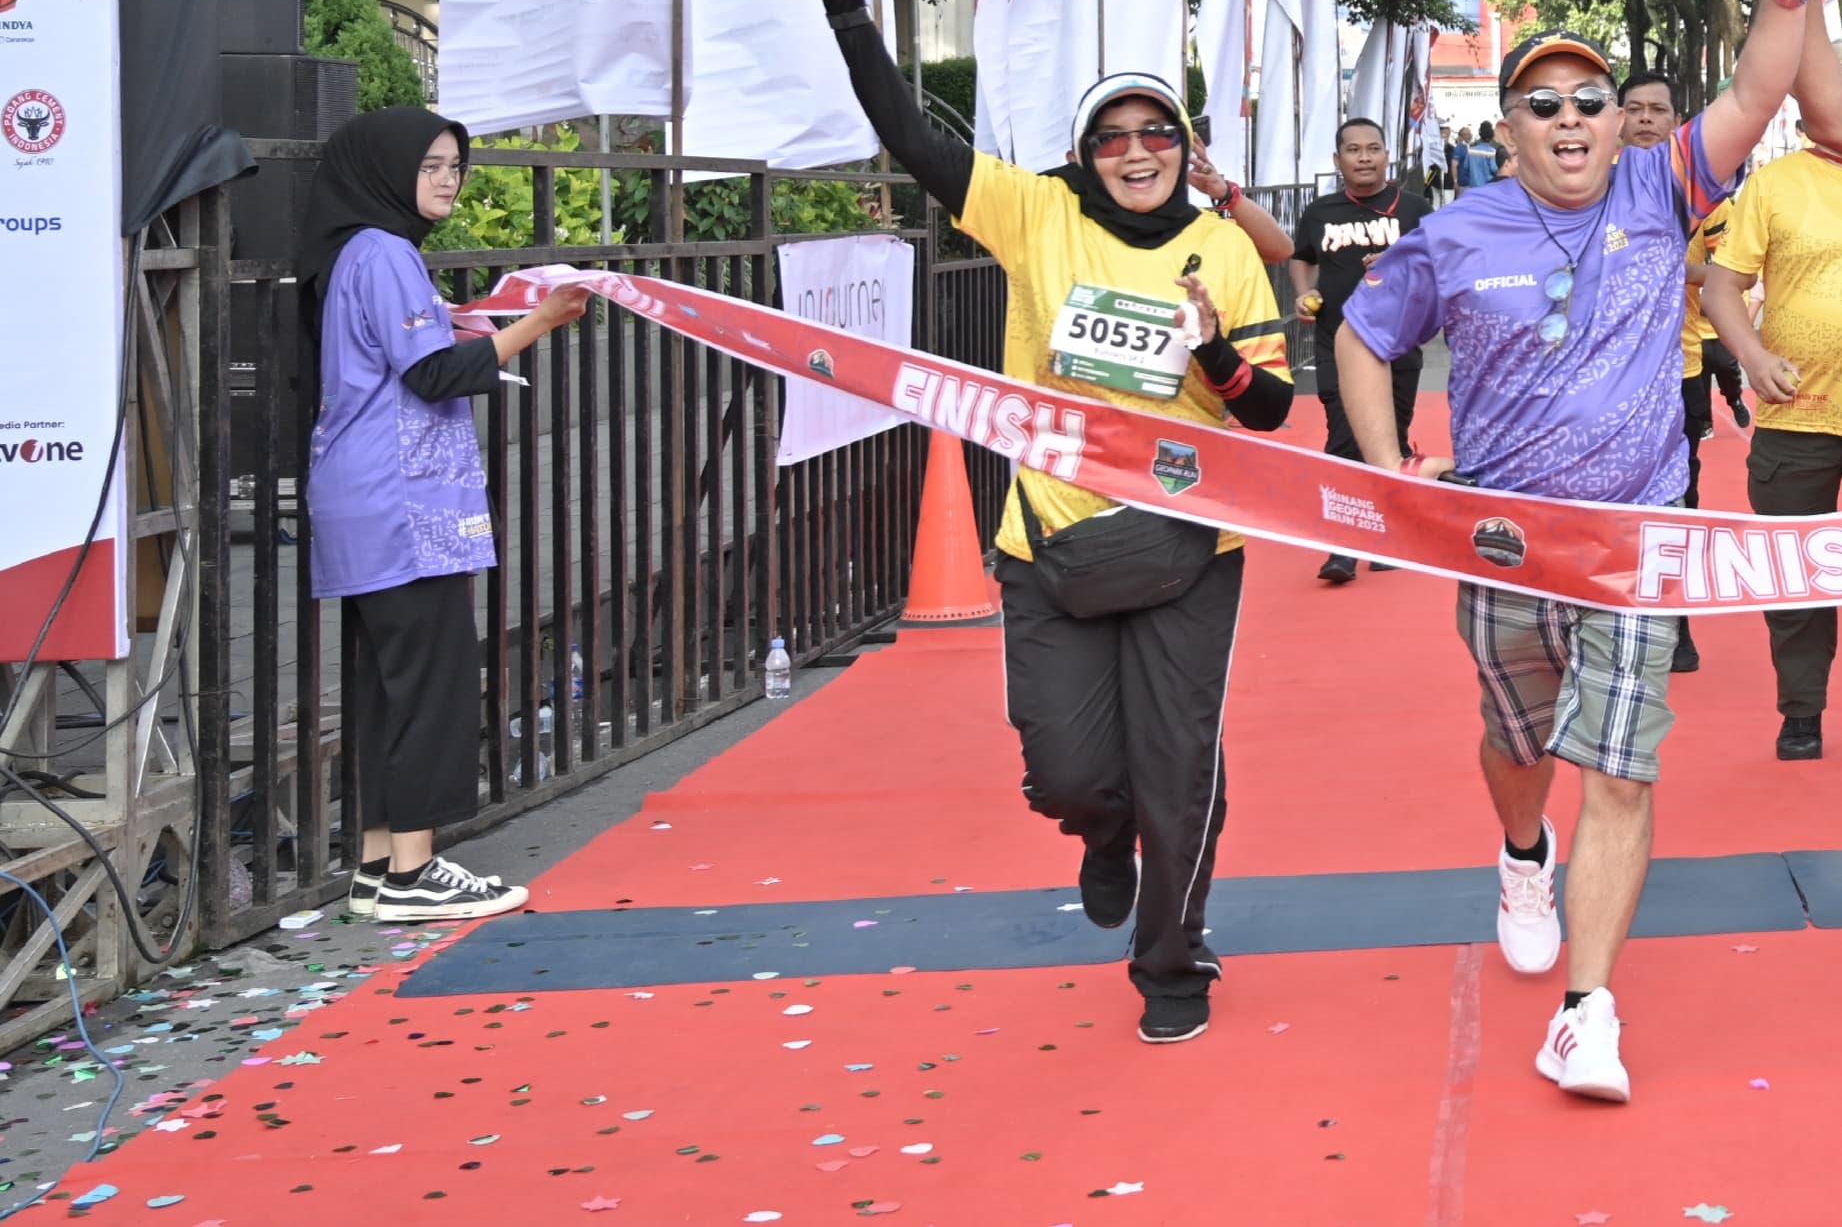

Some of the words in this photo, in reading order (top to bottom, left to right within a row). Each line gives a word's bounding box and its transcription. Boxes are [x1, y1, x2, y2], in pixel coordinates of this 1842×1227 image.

[4, 91, 32, 127] PADANG
[35, 91, 64, 127] CEMENT
[9, 131, 59, 152] INDONESIA
[1474, 274, 1537, 291] OFFICIAL
[1068, 313, 1172, 356] 50537
[23, 420, 65, 429] Partner:
[892, 361, 1086, 482] FINISH
[1328, 491, 1375, 510] MINANG
[1328, 501, 1385, 523] GEOPARK
[1328, 512, 1355, 526] RUN
[1356, 517, 1386, 533] 2023
